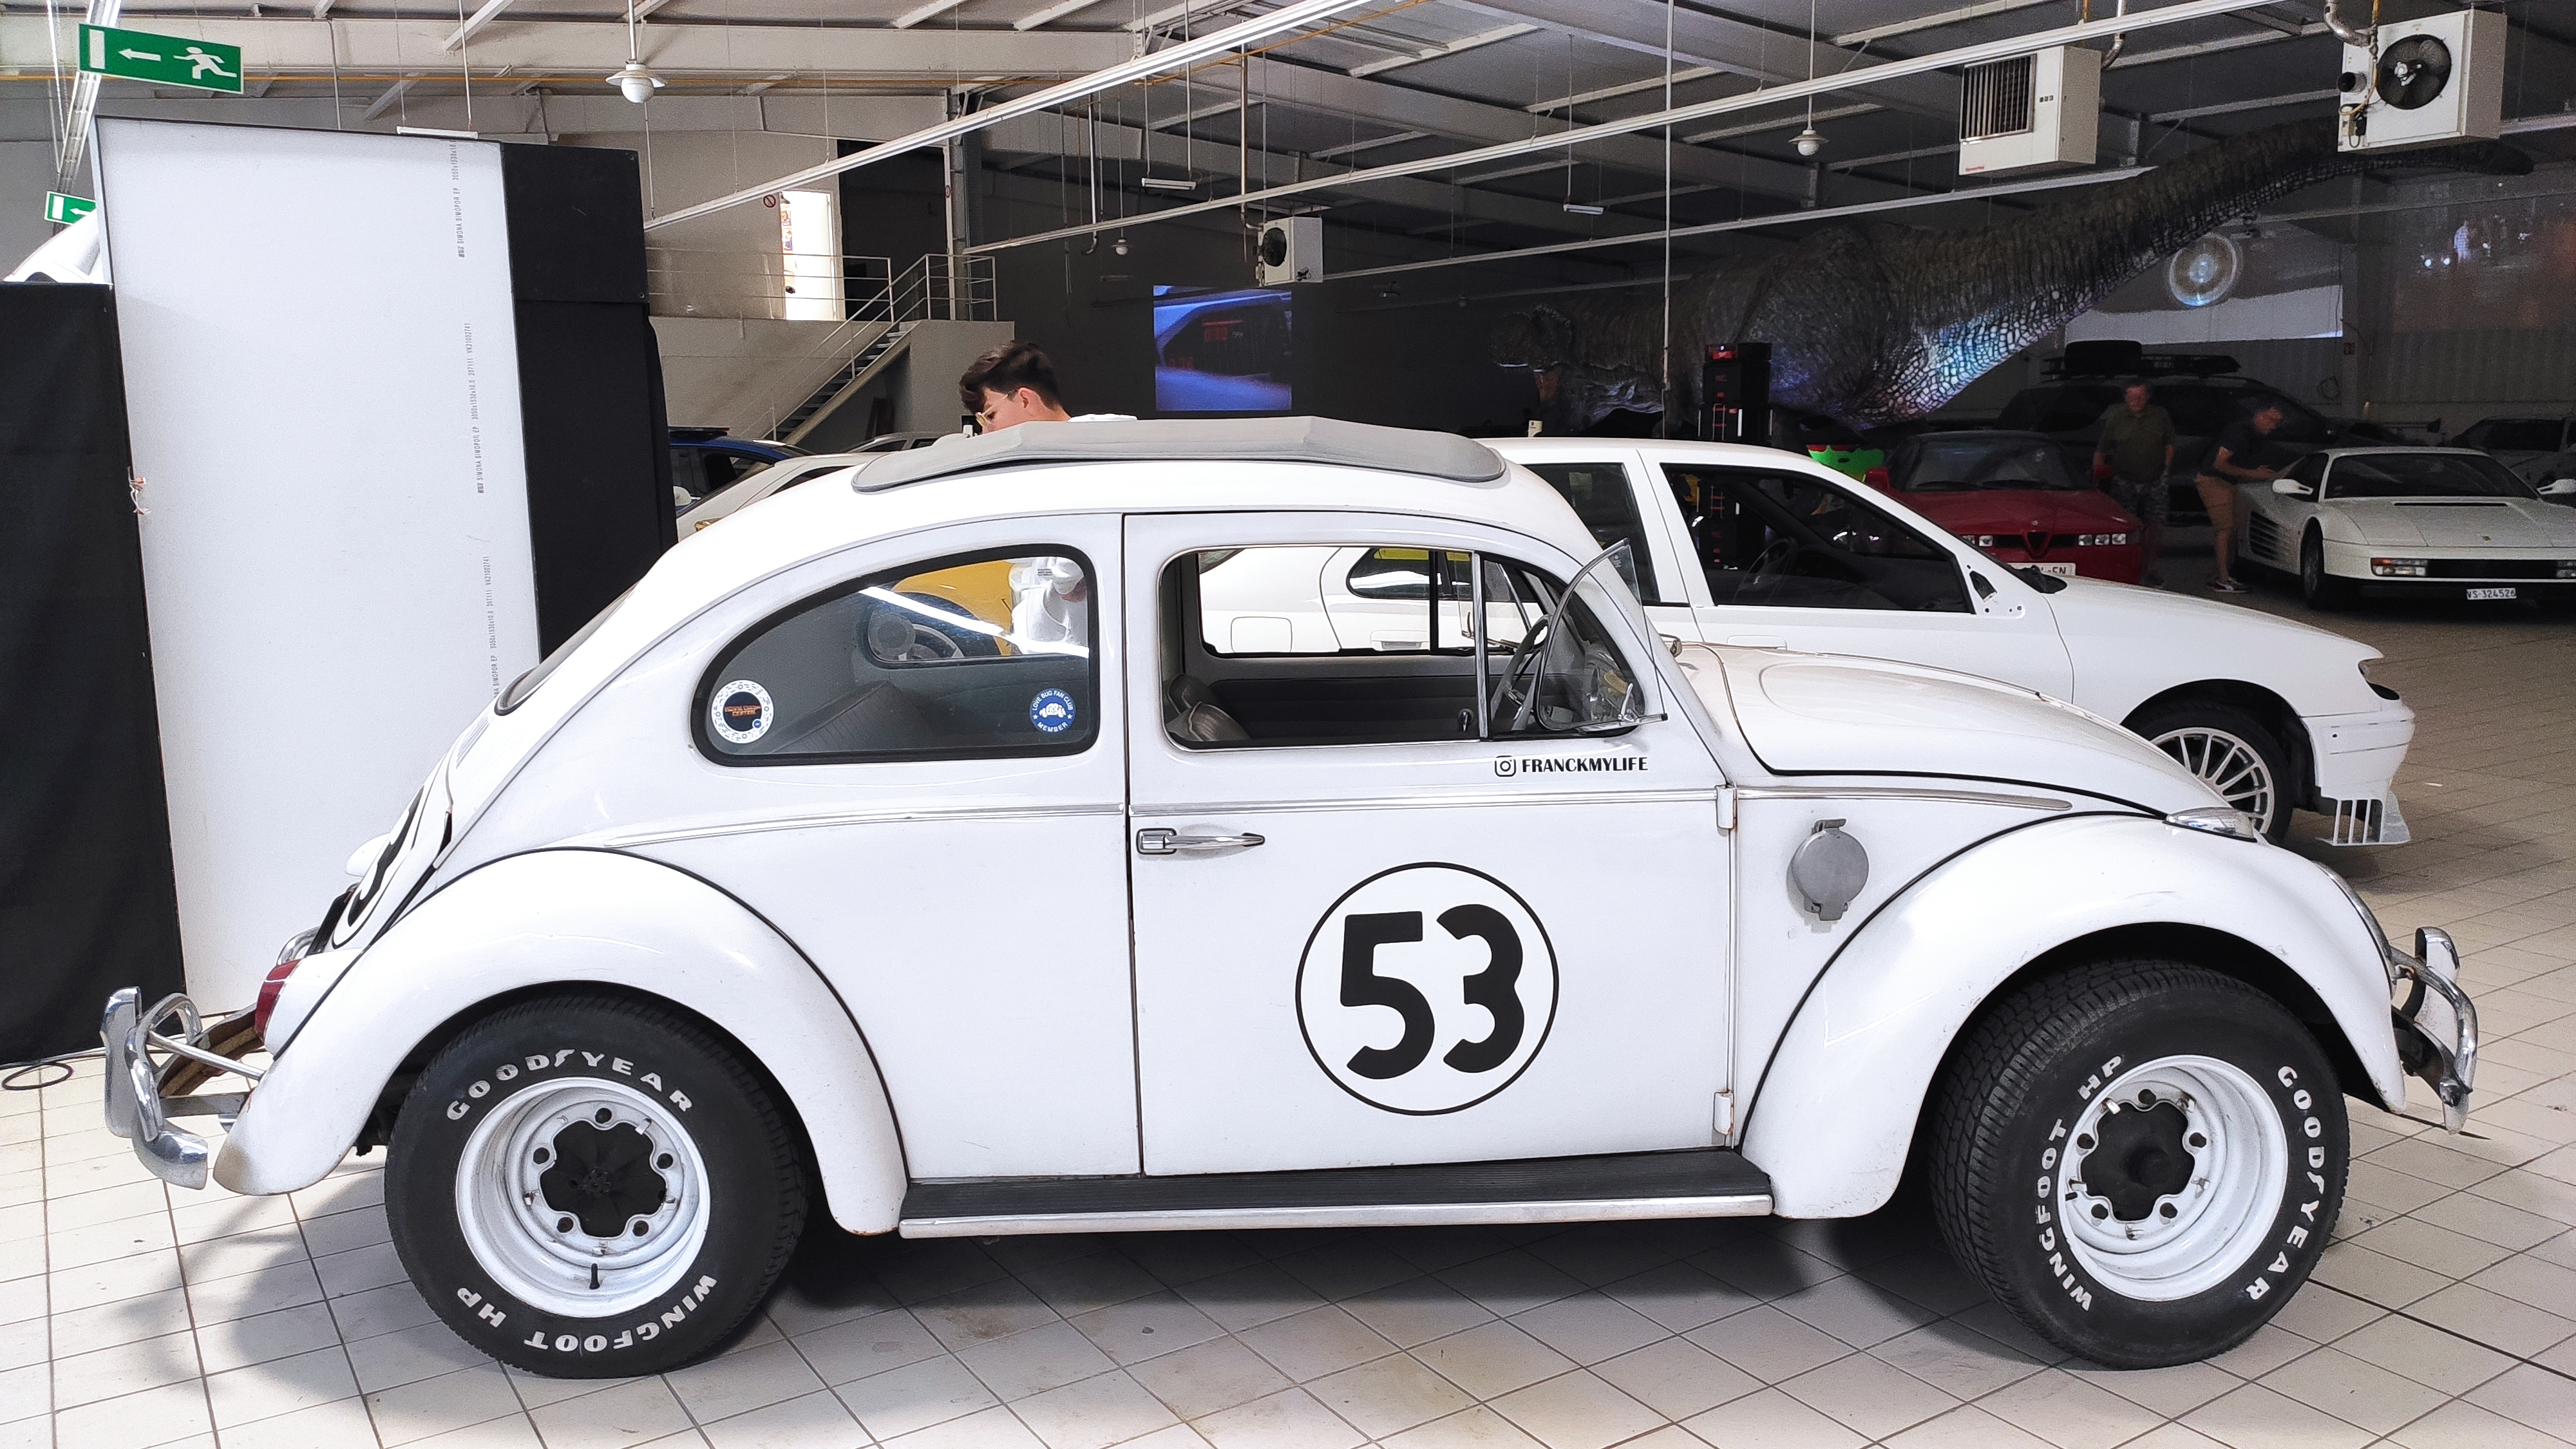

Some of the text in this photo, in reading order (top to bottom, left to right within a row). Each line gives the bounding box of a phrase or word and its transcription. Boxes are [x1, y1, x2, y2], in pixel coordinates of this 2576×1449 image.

[1032, 697, 1042, 710] LOVE
[1064, 696, 1073, 710] CLUB
[1037, 722, 1068, 732] MEMBER
[1522, 757, 1649, 773] FRANCKMYLIFE
[1340, 904, 1525, 1080] 53
[446, 1048, 693, 1121] GOODYEAR
[2034, 1055, 2125, 1312] WINGFOOT HP
[2245, 1065, 2325, 1302] GOODYEAR
[456, 1273, 718, 1353] WINGFOOT HP
